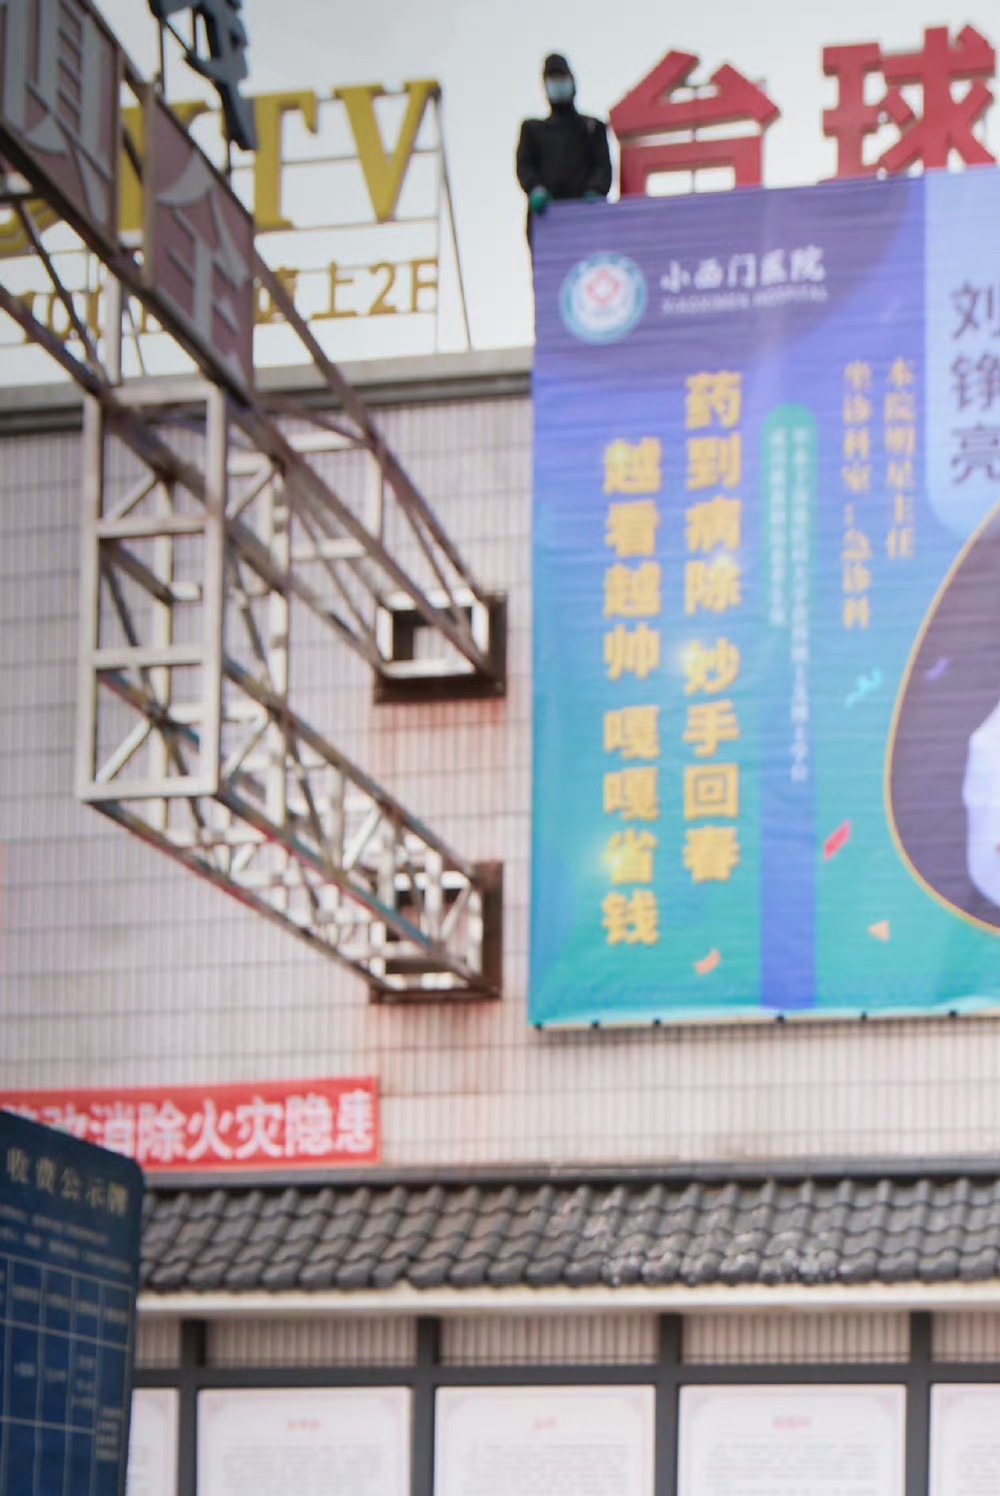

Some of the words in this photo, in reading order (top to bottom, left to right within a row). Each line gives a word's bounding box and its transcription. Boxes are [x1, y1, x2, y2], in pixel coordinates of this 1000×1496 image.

[609, 25, 997, 195] 台球
[603, 438, 662, 680] 越看越帅
[684, 371, 742, 614] 药到病除
[602, 705, 660, 945] 嘎嘎省钱
[683, 638, 740, 882] 妙手回春
[0, 1088, 374, 1163] 改消除火灾隐患
